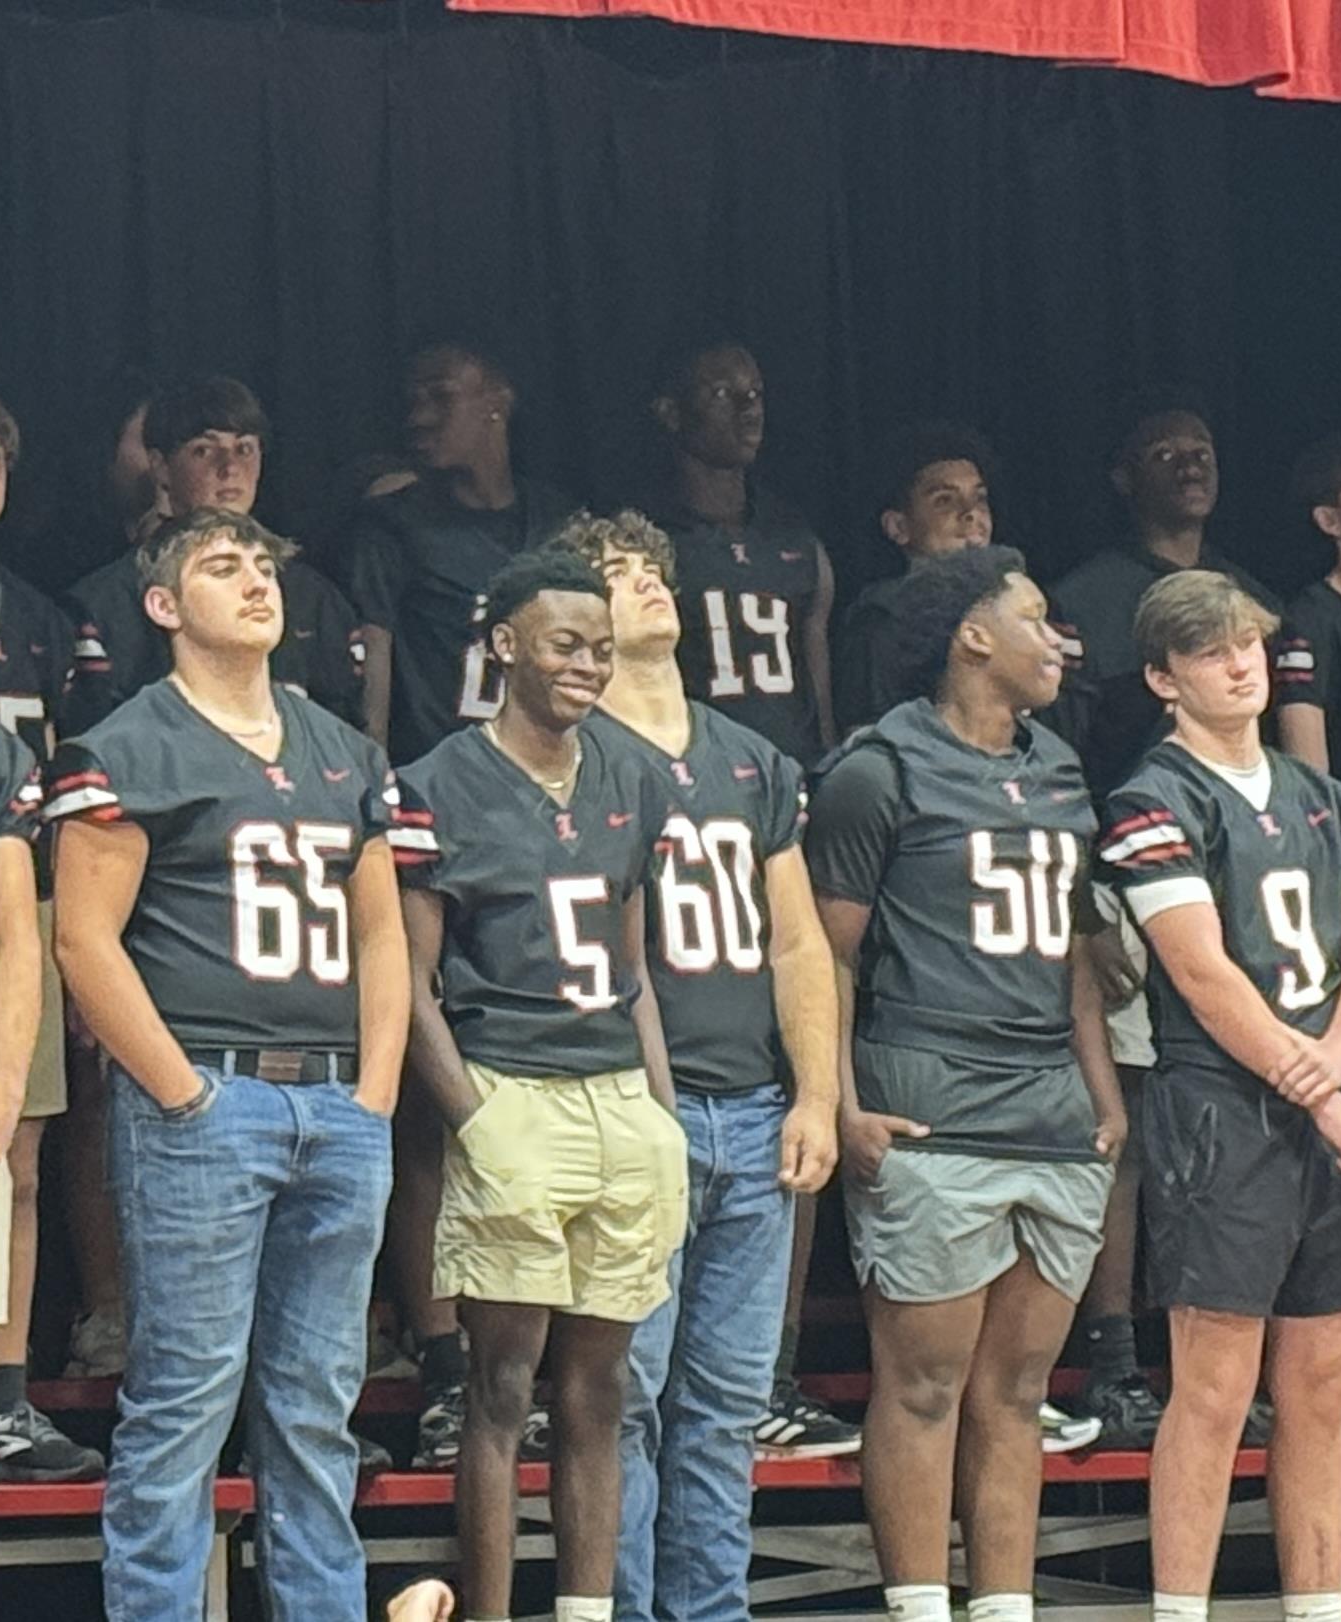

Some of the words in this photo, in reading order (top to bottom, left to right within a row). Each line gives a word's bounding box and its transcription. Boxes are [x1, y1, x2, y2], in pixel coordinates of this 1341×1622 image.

[704, 589, 795, 697] 19
[231, 820, 351, 985] 65
[548, 877, 618, 1012] 5
[661, 814, 763, 973] 60
[971, 829, 1078, 957] 50
[1261, 869, 1326, 1010] 9
